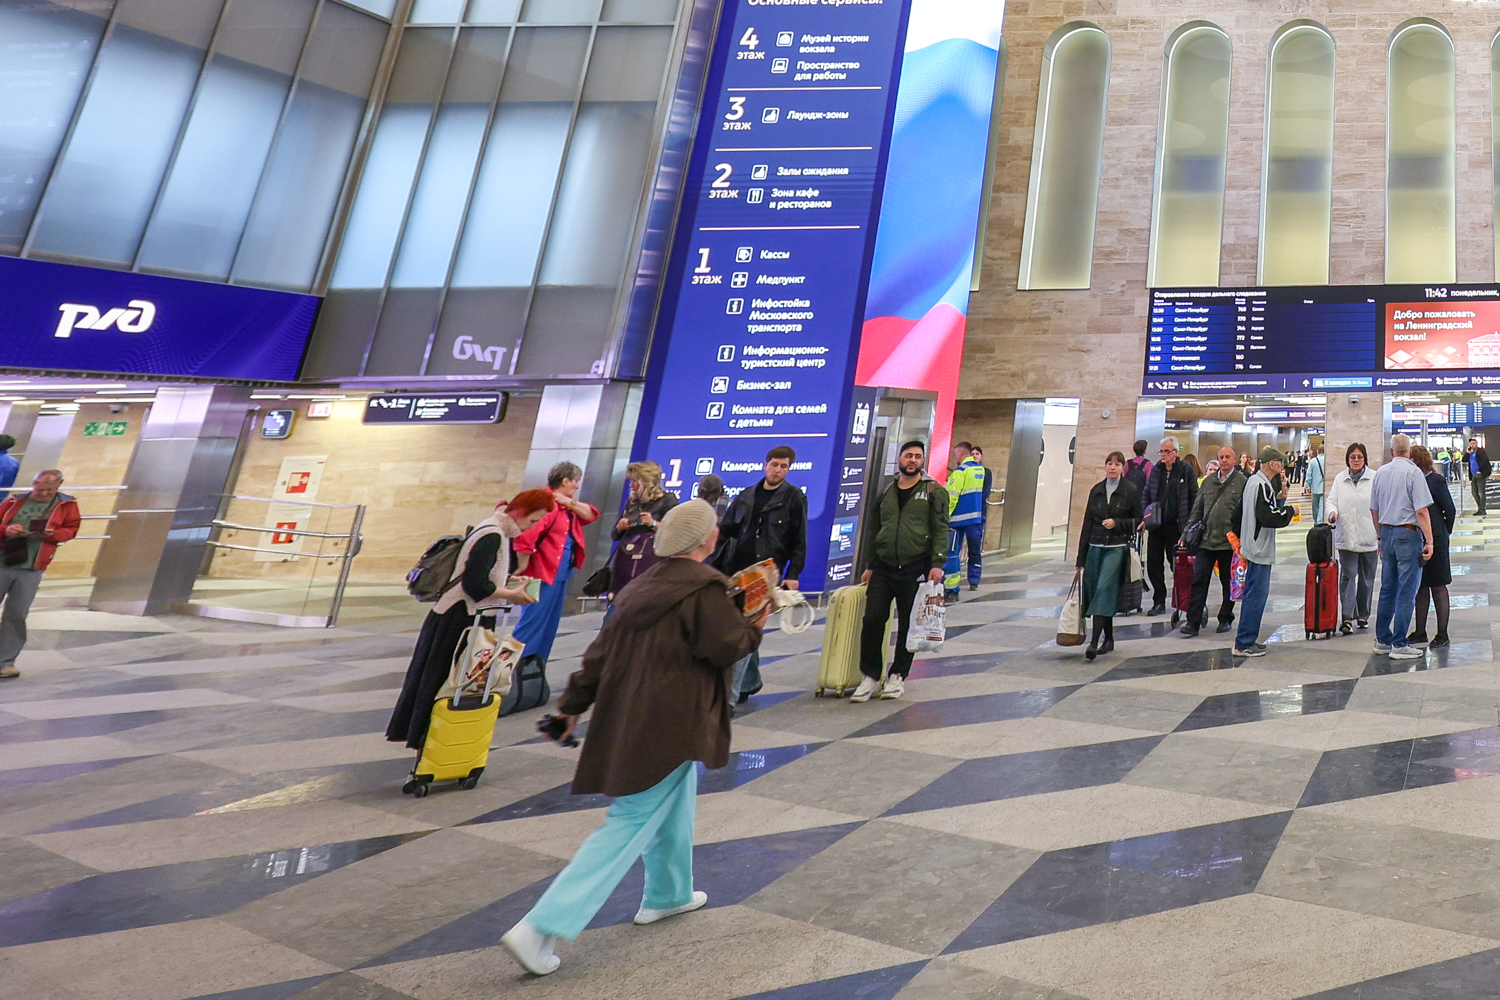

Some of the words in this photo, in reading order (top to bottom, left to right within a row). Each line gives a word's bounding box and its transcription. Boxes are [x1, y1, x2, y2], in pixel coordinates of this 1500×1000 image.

[740, 28, 759, 49] 4
[801, 35, 831, 44] Музей
[797, 61, 860, 71] Пространство
[794, 73, 811, 81] для
[813, 71, 846, 81] работы
[725, 97, 746, 120] 3
[787, 111, 849, 121] Лаундж-зоны
[723, 122, 751, 130] этаж
[712, 163, 732, 187] 2
[777, 167, 801, 175] Залы
[803, 168, 849, 176] ожидания
[709, 190, 738, 198] этаж
[771, 188, 794, 197] Зона
[796, 188, 819, 198] кафе
[769, 201, 776, 209] и
[777, 201, 832, 210] ресторанов
[760, 250, 790, 259] Кассы
[695, 248, 711, 273] 1
[692, 275, 722, 284] этаж
[756, 275, 805, 285] Медпункт
[1425, 288, 1447, 297] 11:42
[752, 298, 810, 309] Инфостойка
[749, 311, 813, 320] Московского
[1394, 310, 1423, 320] Добро
[747, 324, 802, 334] транспорта
[1406, 321, 1473, 330] Ленинградский
[1393, 333, 1426, 341] вокзал!
[743, 345, 829, 357] Информационно-
[741, 358, 795, 369] туристский
[797, 359, 825, 368] центр
[737, 380, 791, 390] Бизнес-зал
[732, 405, 774, 414] Комната
[775, 406, 794, 415] для
[796, 404, 827, 413] семей
[729, 419, 736, 427] с
[736, 419, 773, 428] детьми
[721, 461, 763, 473] Камеры
